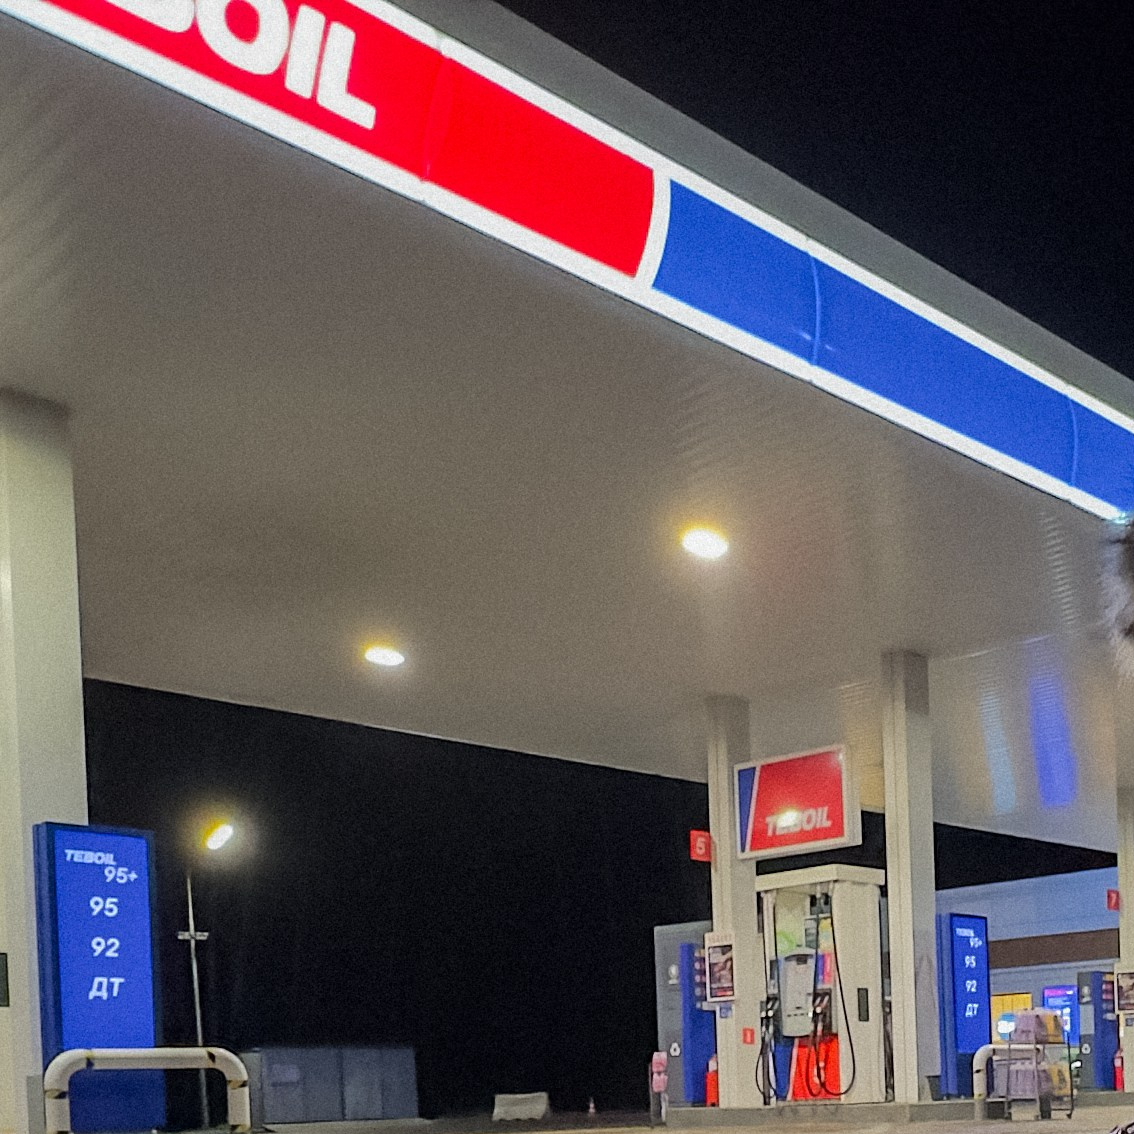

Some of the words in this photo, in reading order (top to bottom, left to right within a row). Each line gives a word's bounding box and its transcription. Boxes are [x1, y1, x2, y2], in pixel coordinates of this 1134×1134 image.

[64, 849, 117, 865] TEBOIL
[104, 866, 138, 884] 95+
[89, 896, 119, 918] 95
[91, 936, 120, 958] 92
[965, 955, 976, 968] 95
[88, 977, 125, 1000] ДТ
[966, 980, 977, 993] 92
